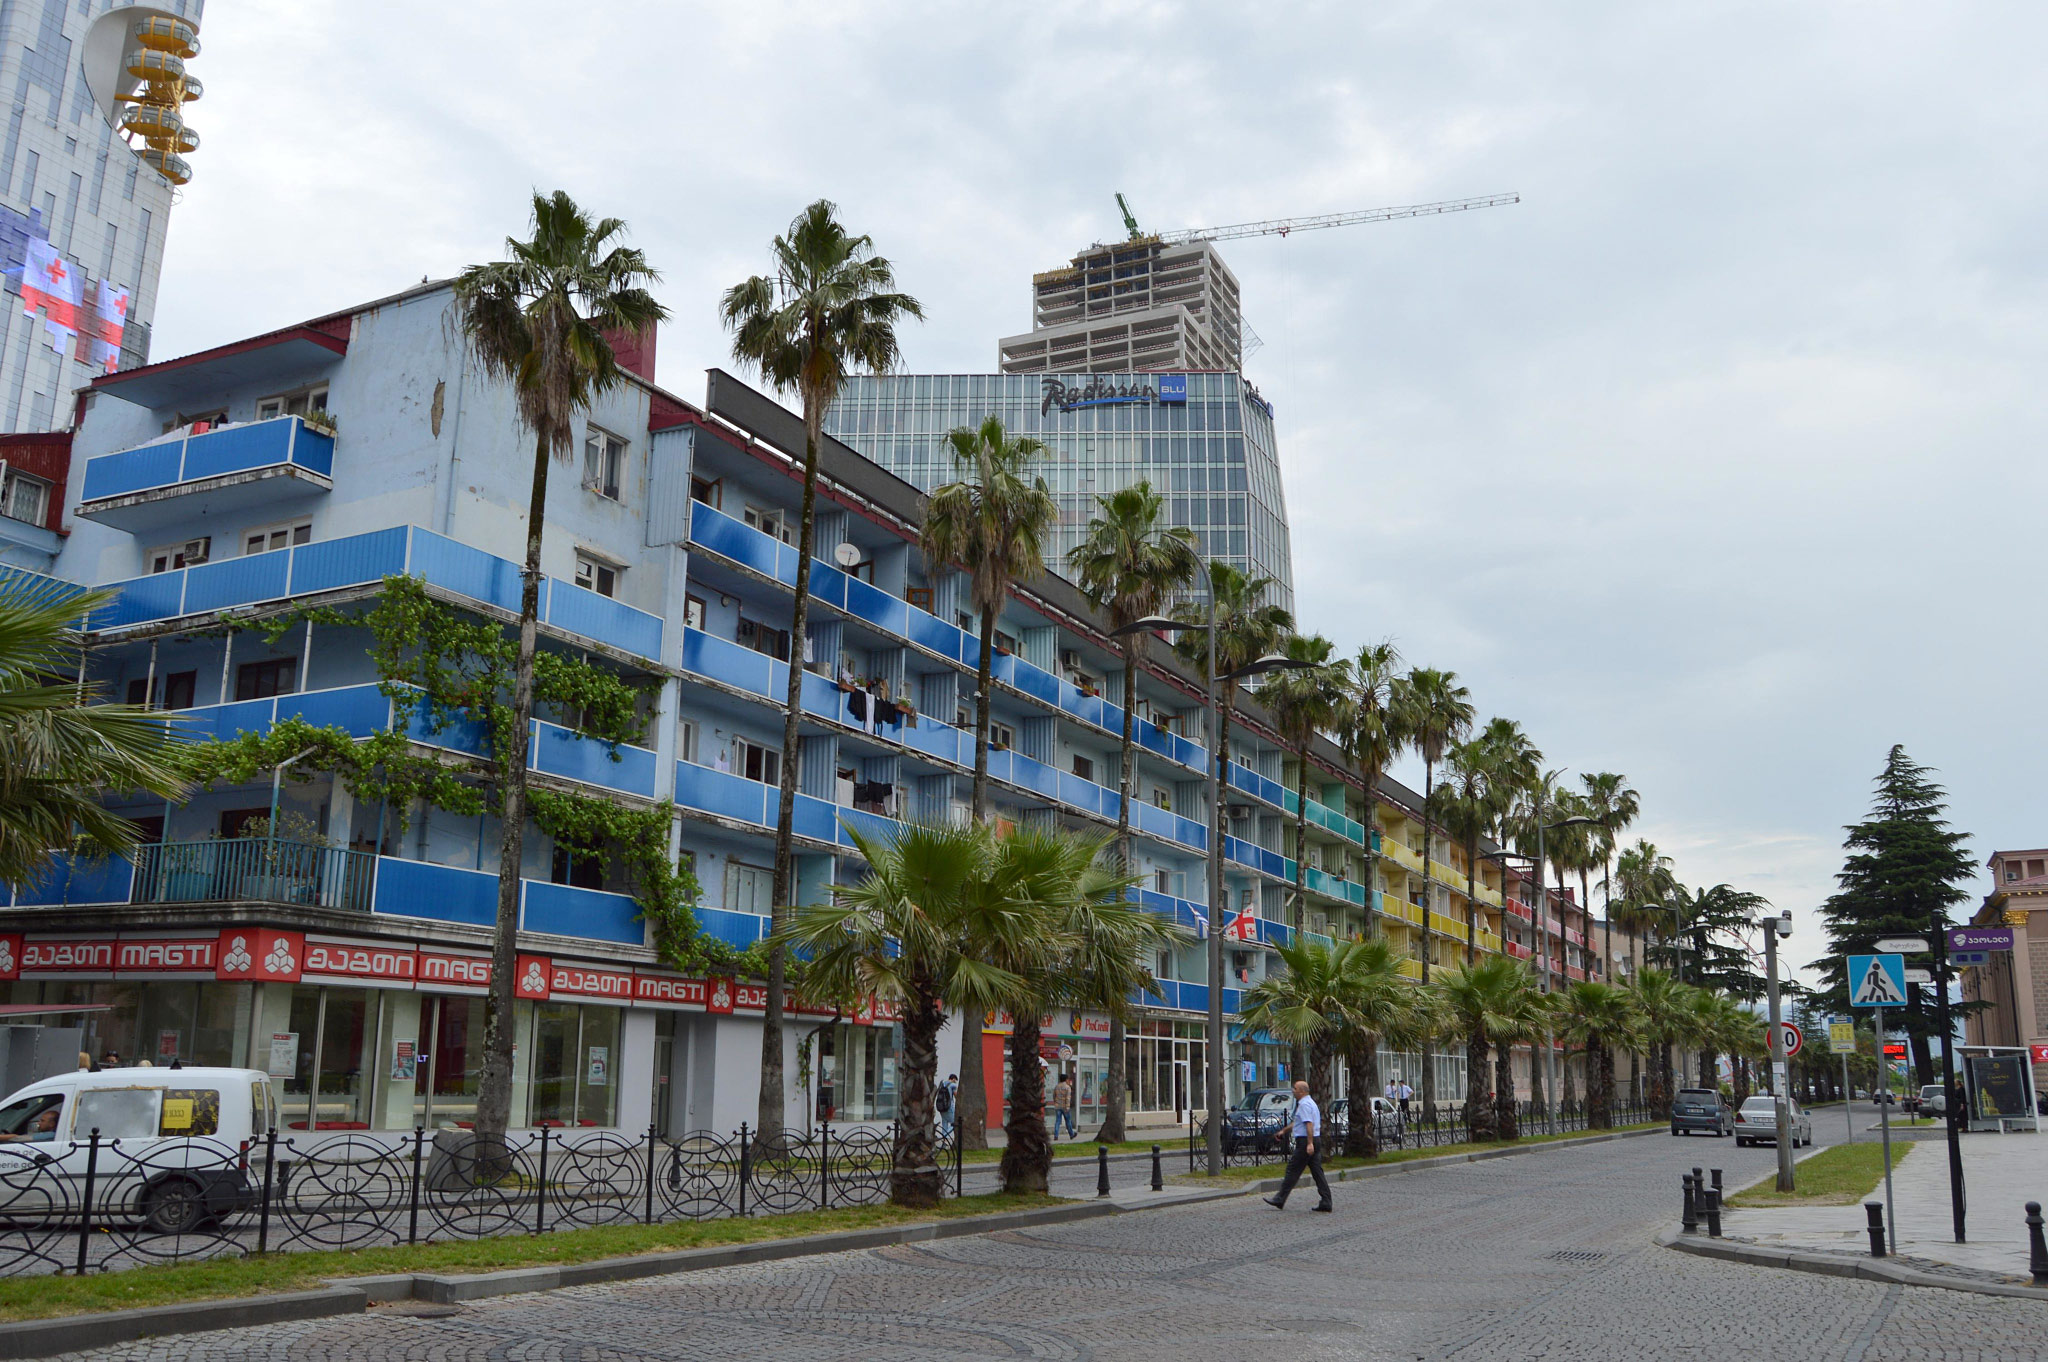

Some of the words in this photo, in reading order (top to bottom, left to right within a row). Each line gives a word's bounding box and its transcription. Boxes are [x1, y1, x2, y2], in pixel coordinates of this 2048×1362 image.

[1041, 373, 1158, 418] Radisson
[1161, 386, 1185, 394] BLU
[23, 945, 111, 965] მაგთი
[121, 945, 210, 965] MAGTI
[307, 948, 414, 975] მაგთი
[425, 958, 493, 981] MAG
[553, 971, 631, 994] მაგთი
[639, 979, 705, 1001] MAGTI
[1085, 1018, 1110, 1032] ProCredit
[0, 1160, 33, 1170] erie.ge
